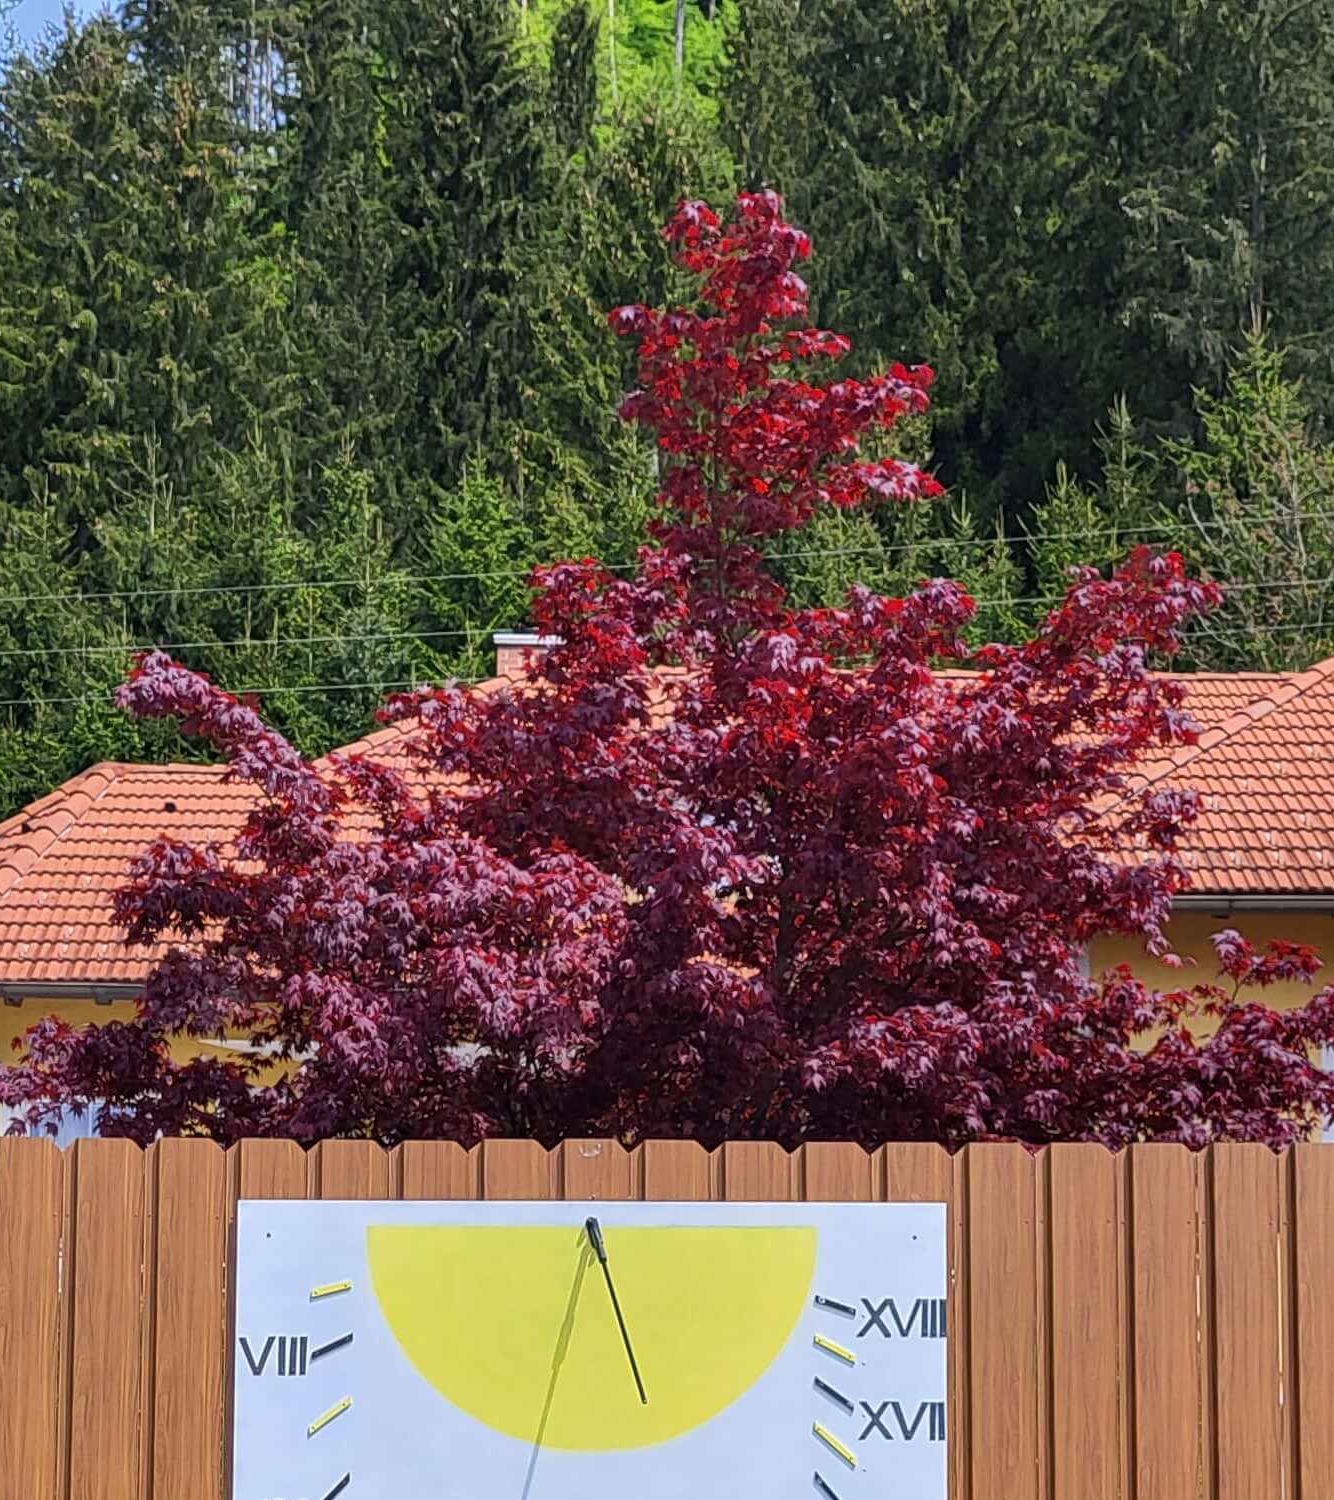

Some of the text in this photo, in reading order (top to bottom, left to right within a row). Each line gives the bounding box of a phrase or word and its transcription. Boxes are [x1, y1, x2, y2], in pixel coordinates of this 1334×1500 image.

[857, 1298, 946, 1338] XVIII
[239, 1336, 308, 1376] VIII
[858, 1402, 946, 1440] XVII
